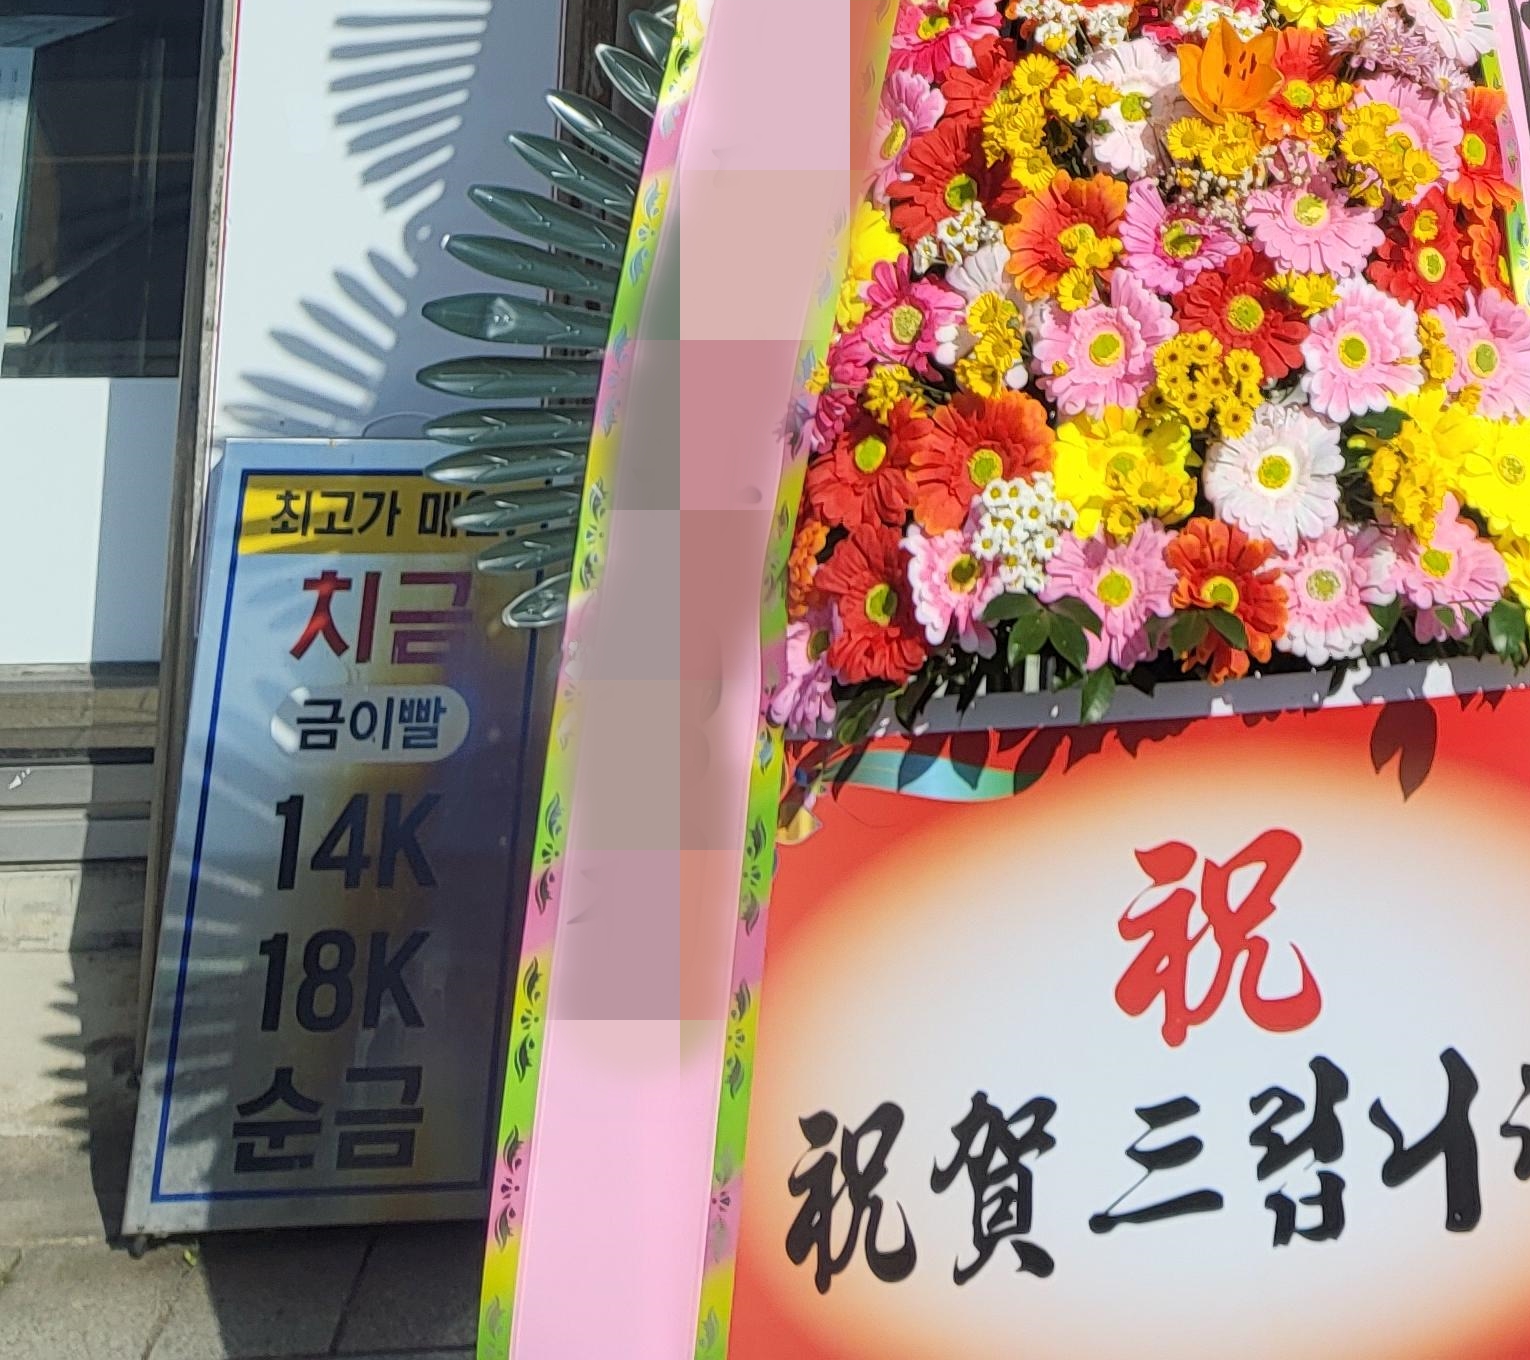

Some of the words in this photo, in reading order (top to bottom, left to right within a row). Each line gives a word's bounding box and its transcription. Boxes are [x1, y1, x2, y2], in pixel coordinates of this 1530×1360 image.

[270, 489, 402, 538] 최고가
[290, 569, 474, 665] 치금
[296, 696, 447, 752] 금이빨
[274, 792, 443, 891] 14K
[258, 929, 433, 1033] 18K
[1113, 827, 1322, 1046] 祝
[232, 1065, 425, 1174] 순금
